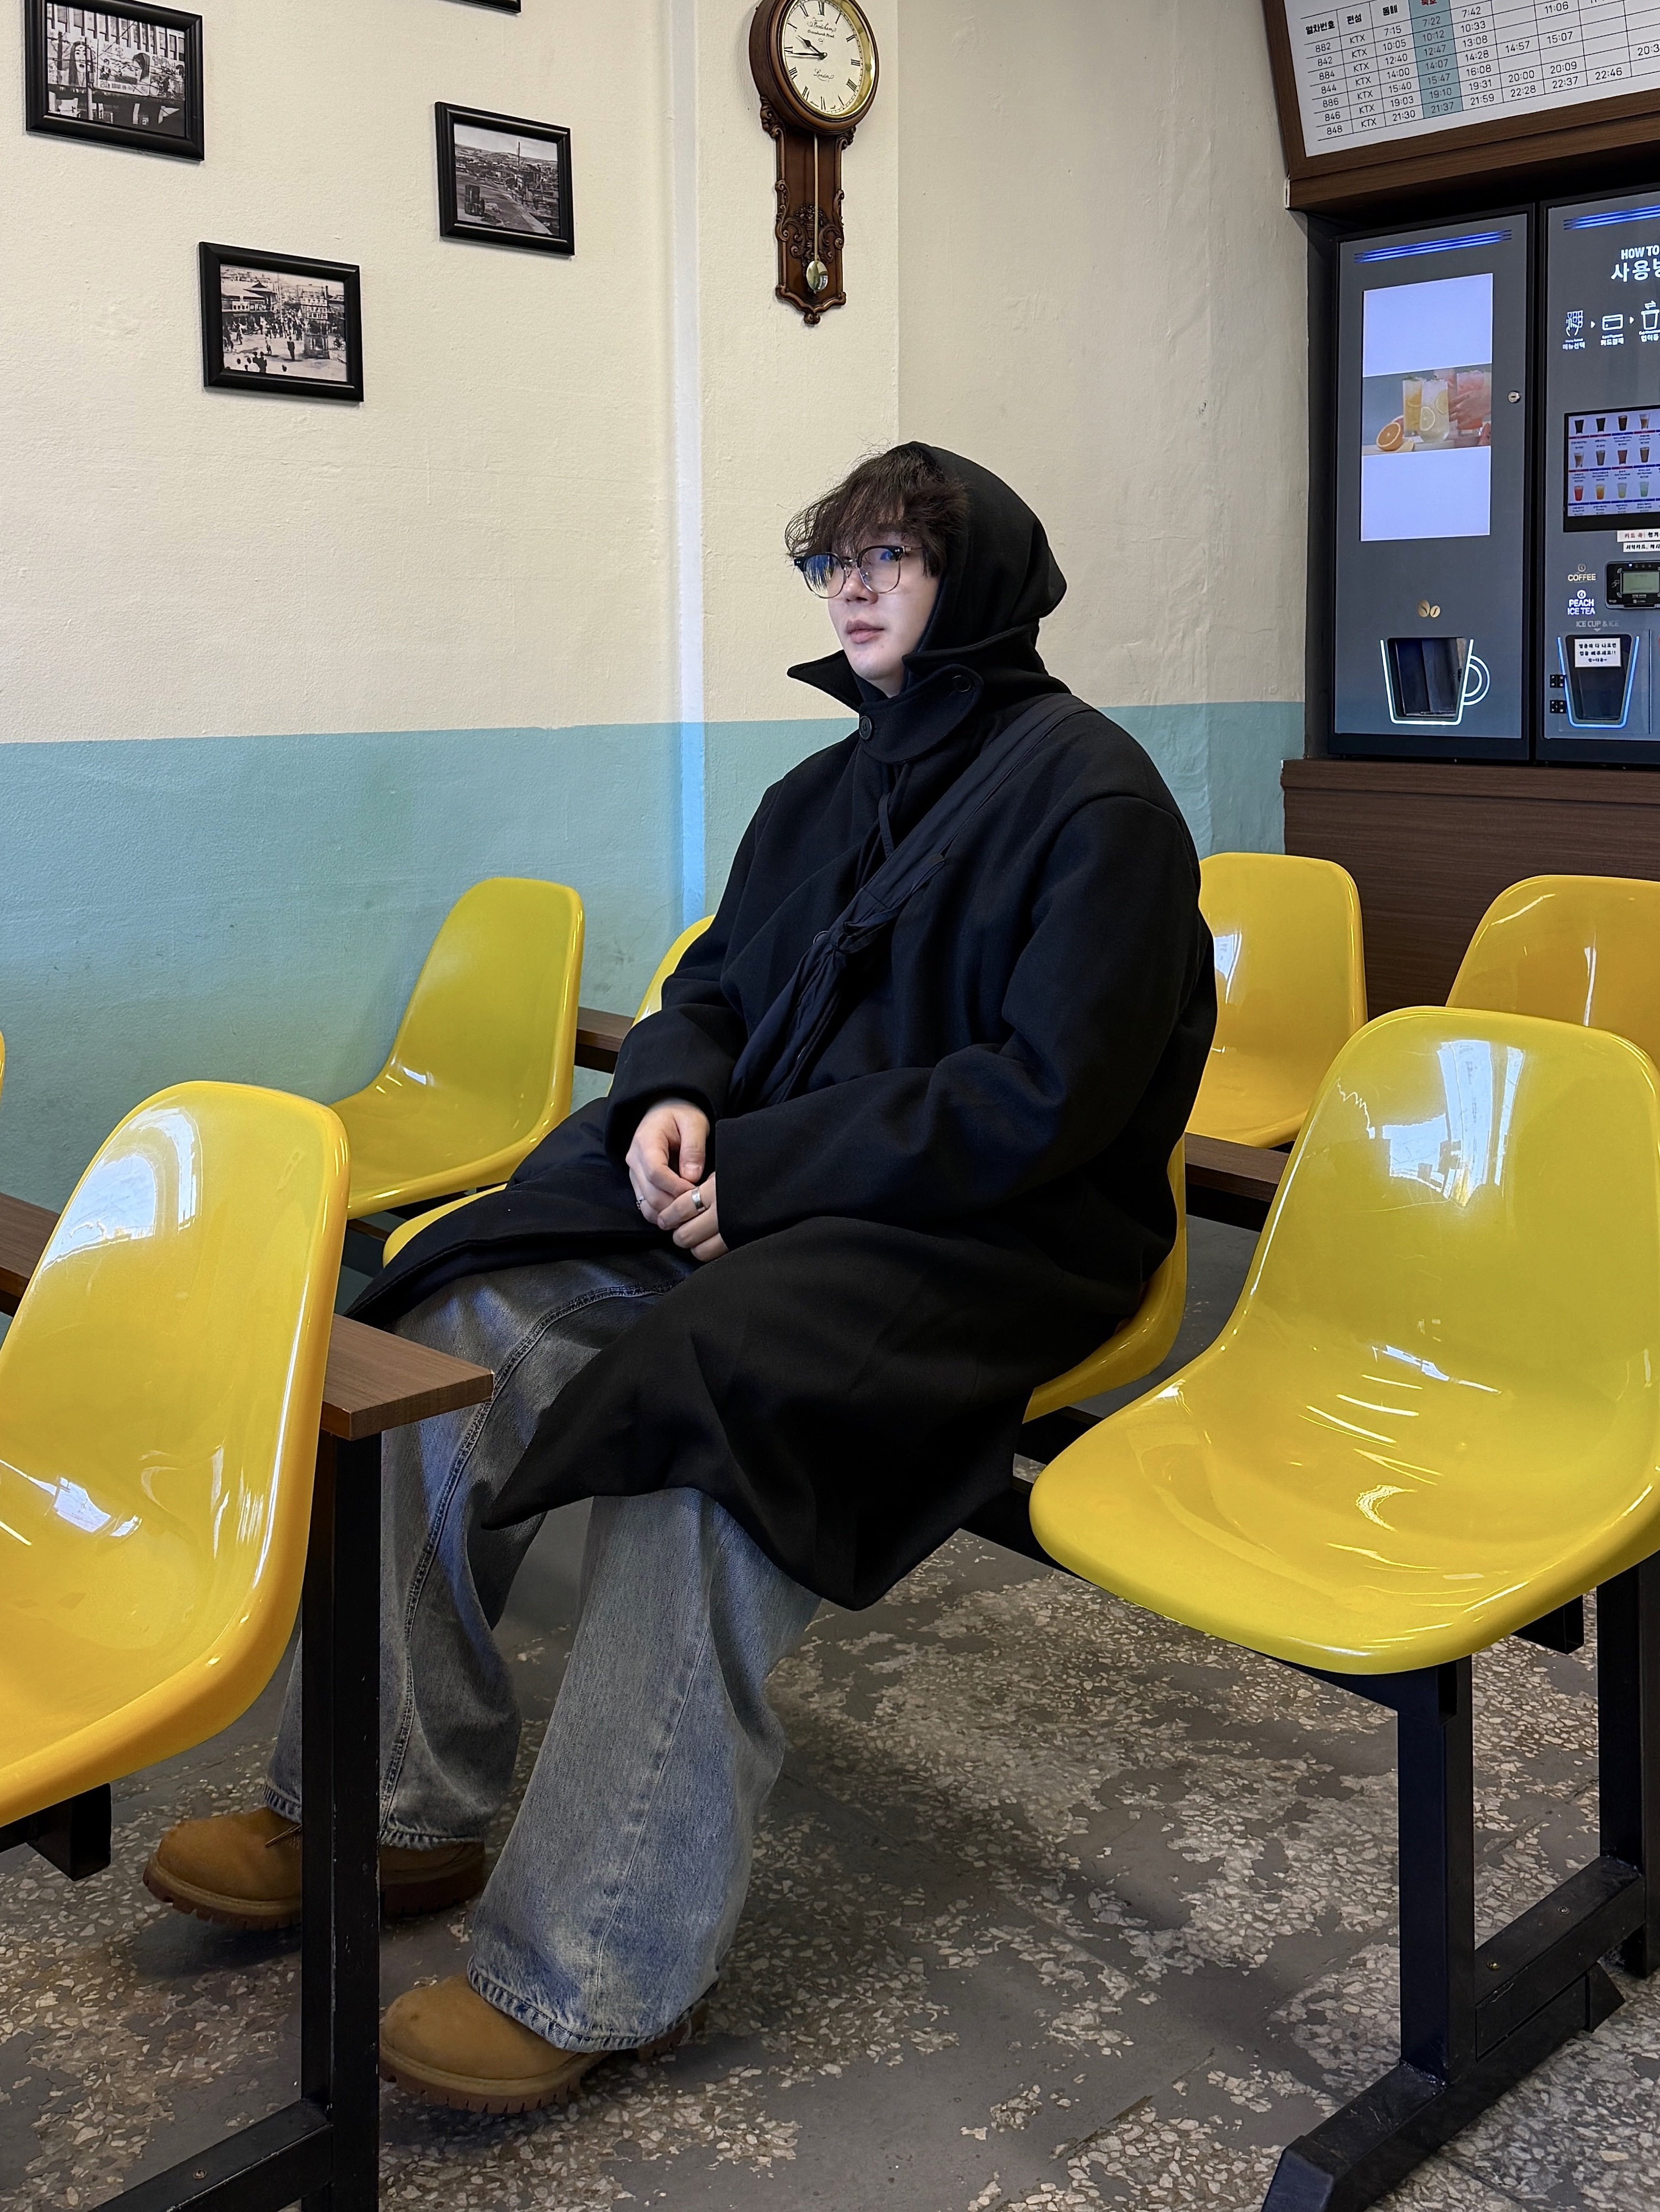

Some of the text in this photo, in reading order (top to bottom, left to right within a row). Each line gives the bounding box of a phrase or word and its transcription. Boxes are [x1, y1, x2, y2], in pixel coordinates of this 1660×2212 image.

[1306, 20, 1335, 35] 열차번호
[1347, 14, 1362, 25] 편성
[1315, 7, 1481, 53] 882 KTX 7:15 7:22 7:42
[1318, 2, 1569, 67] 842 KTX 10:05 10:12 10:33 11:06
[1319, 35, 1488, 80] 884 KTX 12:40 12:47 13:08
[1321, 32, 1573, 94] 844 KTX 14:00 14:07 14:28 14:57 15:07
[1323, 65, 1492, 108] 886 KTX 15:40 15:47 16:08
[1325, 111, 1340, 122] 846
[1359, 104, 1375, 114] KTX
[1390, 96, 1414, 108] 19:03
[1429, 87, 1452, 99] 19:10
[1469, 79, 1492, 91] 19:31
[1508, 70, 1534, 83] 20:00
[1550, 61, 1577, 74] 20:09
[1326, 67, 1622, 135] 848 KTX 21:30 21:37 21:59 22:28 22:37 22:46
[1621, 244, 1659, 260] HOW TO
[1568, 573, 1596, 581] COFFEE
[1569, 599, 1594, 607] PEACH
